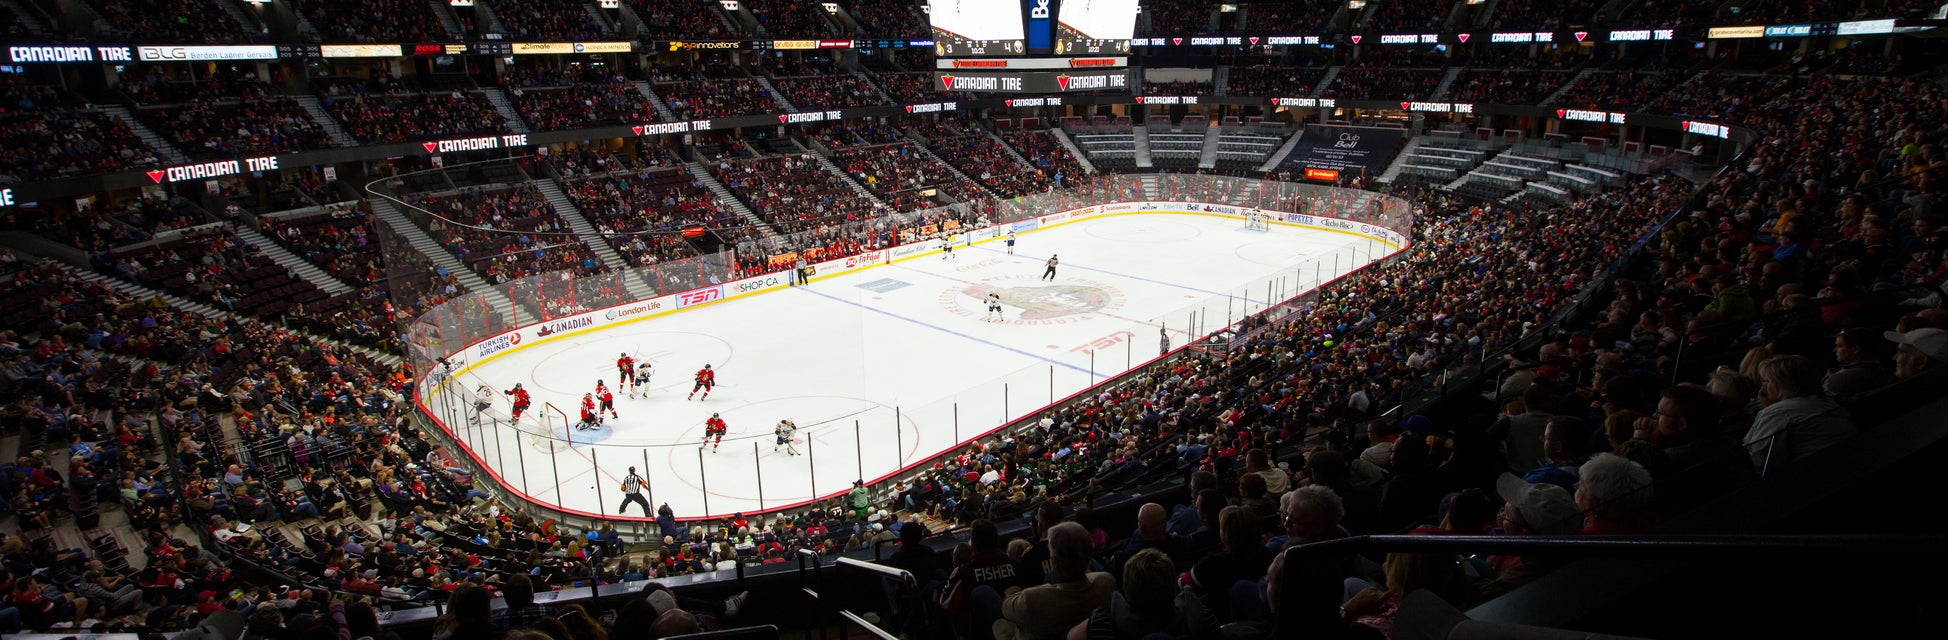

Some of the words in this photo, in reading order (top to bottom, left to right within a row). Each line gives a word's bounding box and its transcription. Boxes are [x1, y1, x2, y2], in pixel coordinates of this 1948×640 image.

[1304, 36, 1319, 44] TIRE
[1381, 35, 1418, 43] CANADIAN
[1421, 34, 1438, 42] TIRE
[1492, 33, 1532, 42] CANADIAN
[1535, 32, 1553, 42] TIRE
[1610, 31, 1650, 41] CANADIAN
[1654, 30, 1673, 40] TIRE
[1004, 43, 1011, 52] 4
[1066, 42, 1073, 52] 3
[1116, 42, 1121, 51] 4
[1151, 38, 1165, 46] TIRE
[144, 48, 186, 59] BLG
[415, 44, 440, 52] ROSS
[946, 44, 953, 53] 3
[10, 47, 92, 62] CANADIAN
[98, 47, 132, 60] TIRE
[954, 76, 997, 90] CANADIAN
[1002, 77, 1022, 90] TIRE
[1069, 76, 1106, 90] CANADIAN
[1110, 74, 1125, 87] TIRE
[1012, 98, 1044, 106] CANADIAN
[1046, 98, 1062, 106] TIRE
[1144, 96, 1179, 104] CANADIAN
[1182, 96, 1198, 104] TIRE
[1280, 98, 1316, 106] CANADIAN
[1319, 99, 1335, 108] TIRE
[913, 104, 941, 113] CANADIAN
[944, 102, 957, 111] TIRE
[1410, 102, 1450, 112] CANADIAN
[1454, 104, 1472, 112] TIRE
[788, 112, 824, 124] CANADIAN
[827, 110, 841, 120] TIRE
[1566, 110, 1606, 122] CANADIAN
[1610, 112, 1626, 124] TIRE
[644, 122, 688, 136] CANADIAN
[692, 120, 711, 130] TIRE
[1689, 121, 1719, 136] CANADIAN
[1720, 126, 1730, 139] TIRE
[1340, 132, 1360, 141] Club
[438, 136, 498, 152] CANADIAN
[503, 134, 528, 146] TIRE
[1334, 140, 1358, 148] Bell
[168, 160, 240, 182] CANADIAN
[246, 156, 278, 172] TIRE
[1212, 206, 1236, 214] CANADIAN
[680, 288, 719, 306] TSN
[618, 306, 647, 317] London
[648, 302, 661, 310] Life
[551, 316, 592, 334] CANADIAN
[478, 335, 509, 350] TURKISH
[1069, 330, 1136, 354] TSN
[480, 342, 510, 358] AIRLINES
[974, 564, 1016, 582] FISHER
